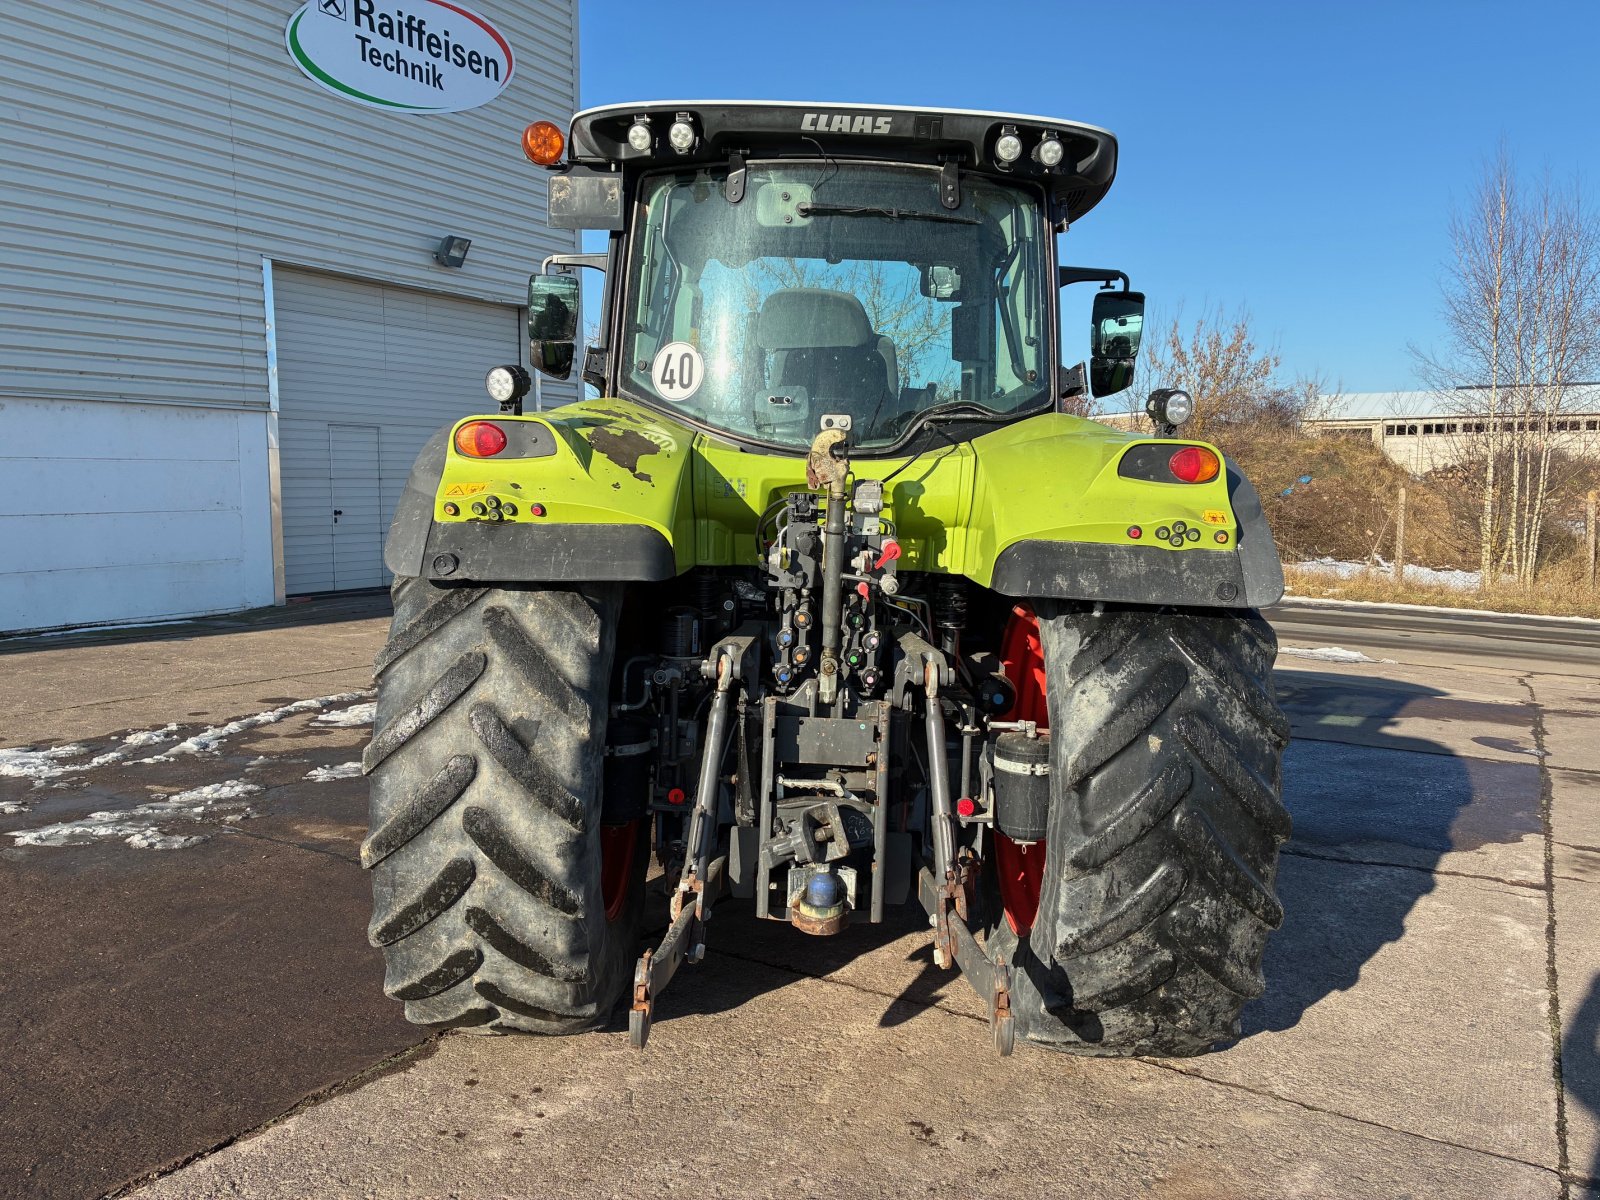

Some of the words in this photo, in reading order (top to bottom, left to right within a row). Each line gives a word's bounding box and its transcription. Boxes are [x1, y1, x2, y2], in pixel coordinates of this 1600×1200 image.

[354, 0, 500, 82] Raiffeisen
[355, 34, 445, 91] Technik
[800, 113, 893, 134] CLAAS
[660, 352, 694, 390] 40
